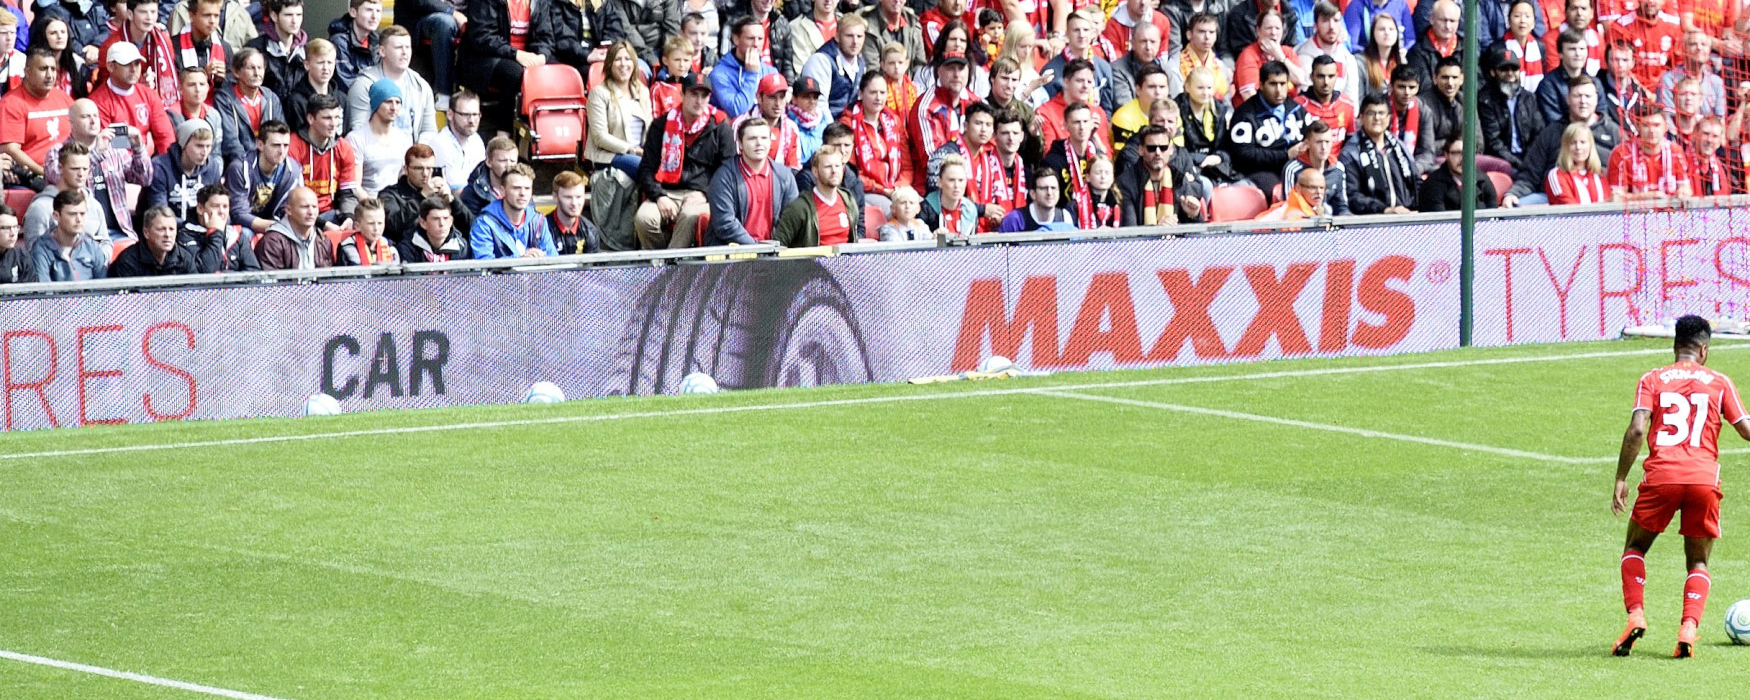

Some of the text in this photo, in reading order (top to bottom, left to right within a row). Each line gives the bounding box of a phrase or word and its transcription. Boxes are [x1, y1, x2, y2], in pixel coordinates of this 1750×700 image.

[951, 255, 1416, 373] MAXXIS
[3, 321, 197, 430] RES
[320, 329, 450, 400] CAR
[1656, 391, 1709, 447] 31
